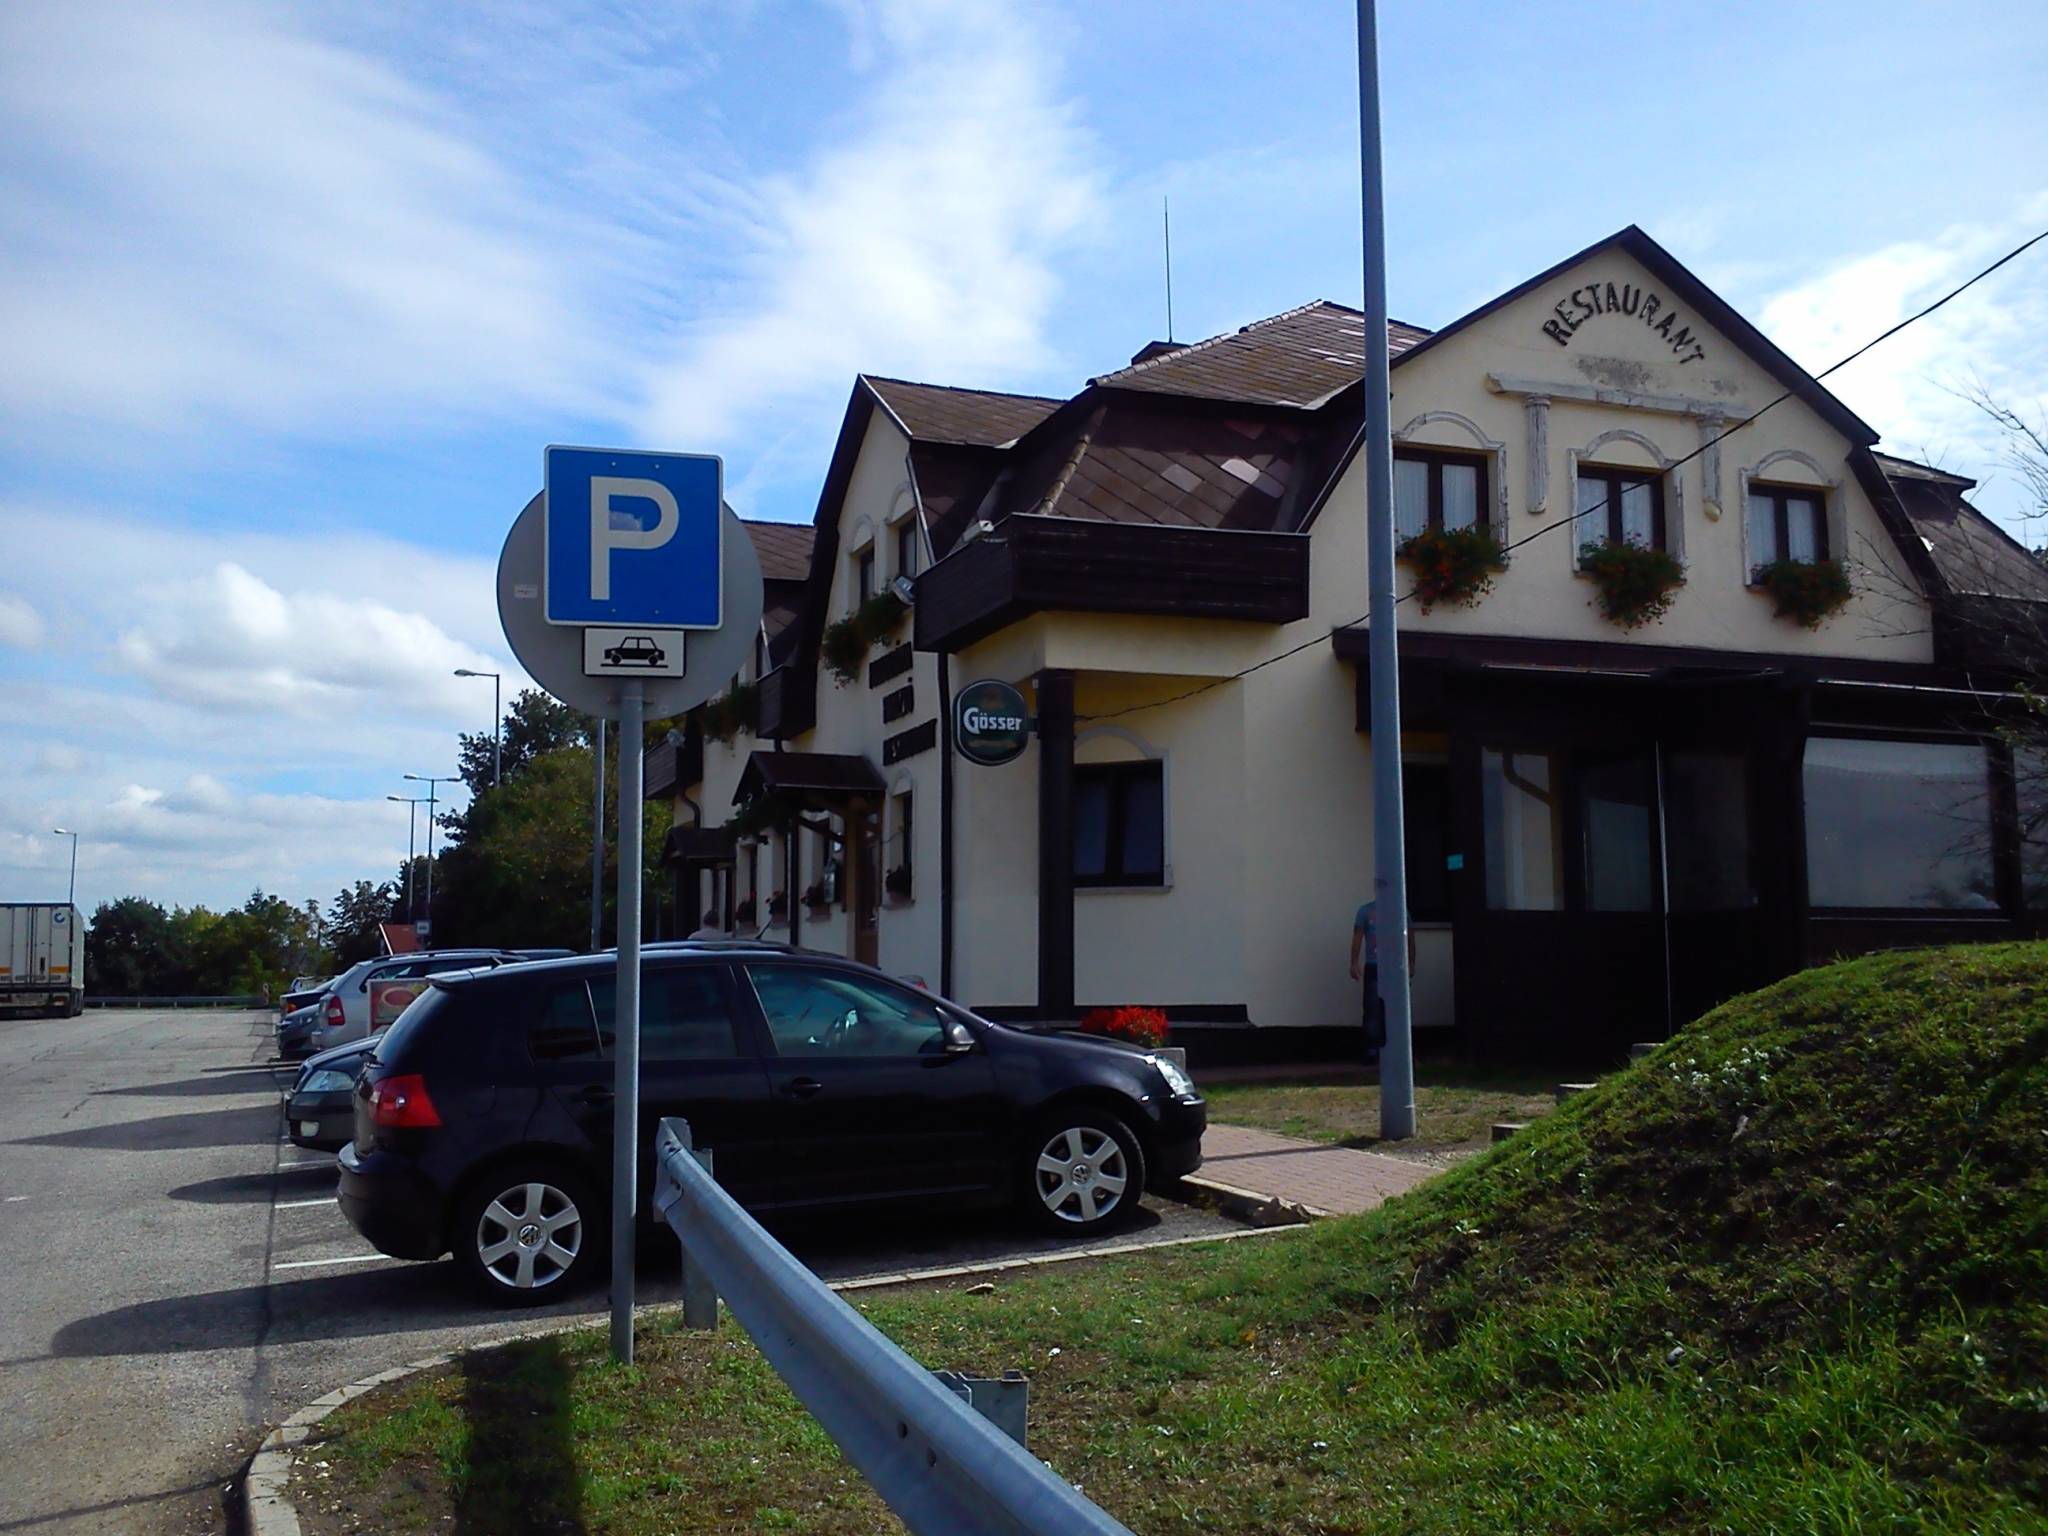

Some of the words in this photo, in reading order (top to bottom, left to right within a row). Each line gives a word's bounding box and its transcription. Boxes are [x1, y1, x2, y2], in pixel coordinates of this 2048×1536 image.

[1542, 282, 1704, 364] RESTAURANT
[590, 475, 679, 600] P
[963, 707, 1022, 734] Gösser
